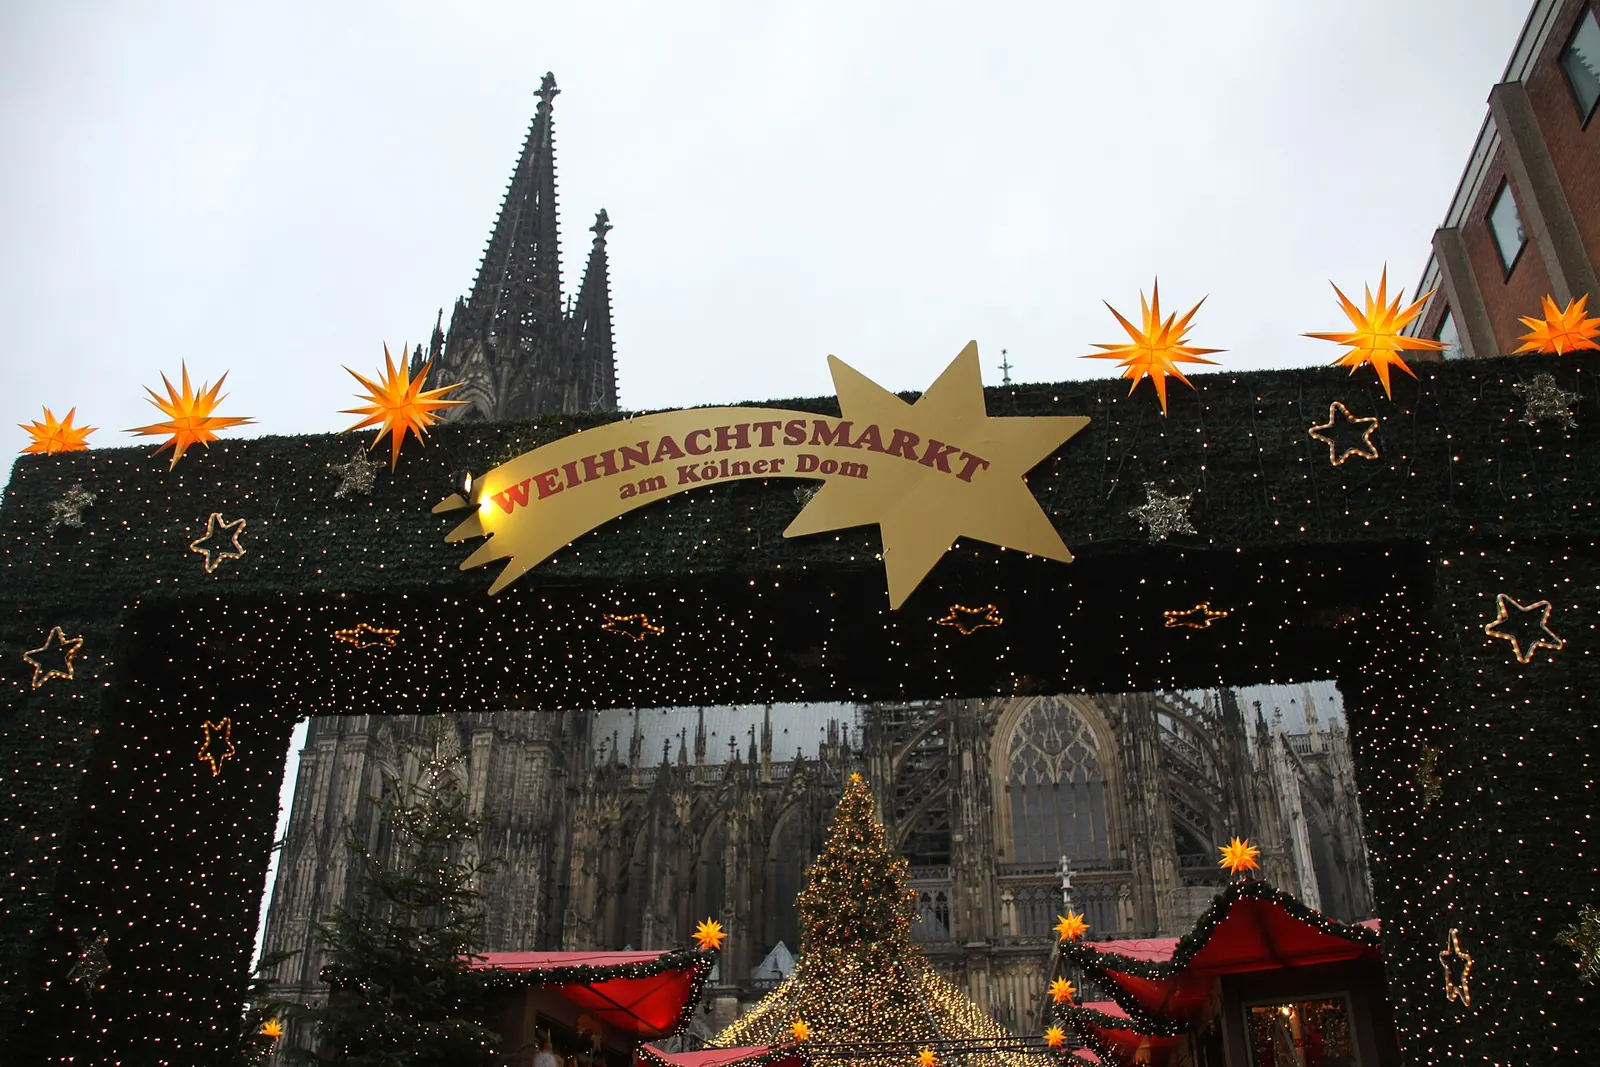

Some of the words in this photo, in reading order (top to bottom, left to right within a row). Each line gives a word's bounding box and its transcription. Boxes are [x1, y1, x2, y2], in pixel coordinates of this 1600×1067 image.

[491, 419, 990, 515] WEIHNACHTSMARKT
[619, 474, 667, 500] am
[677, 457, 786, 485] Kölner
[795, 453, 869, 480] Dom
